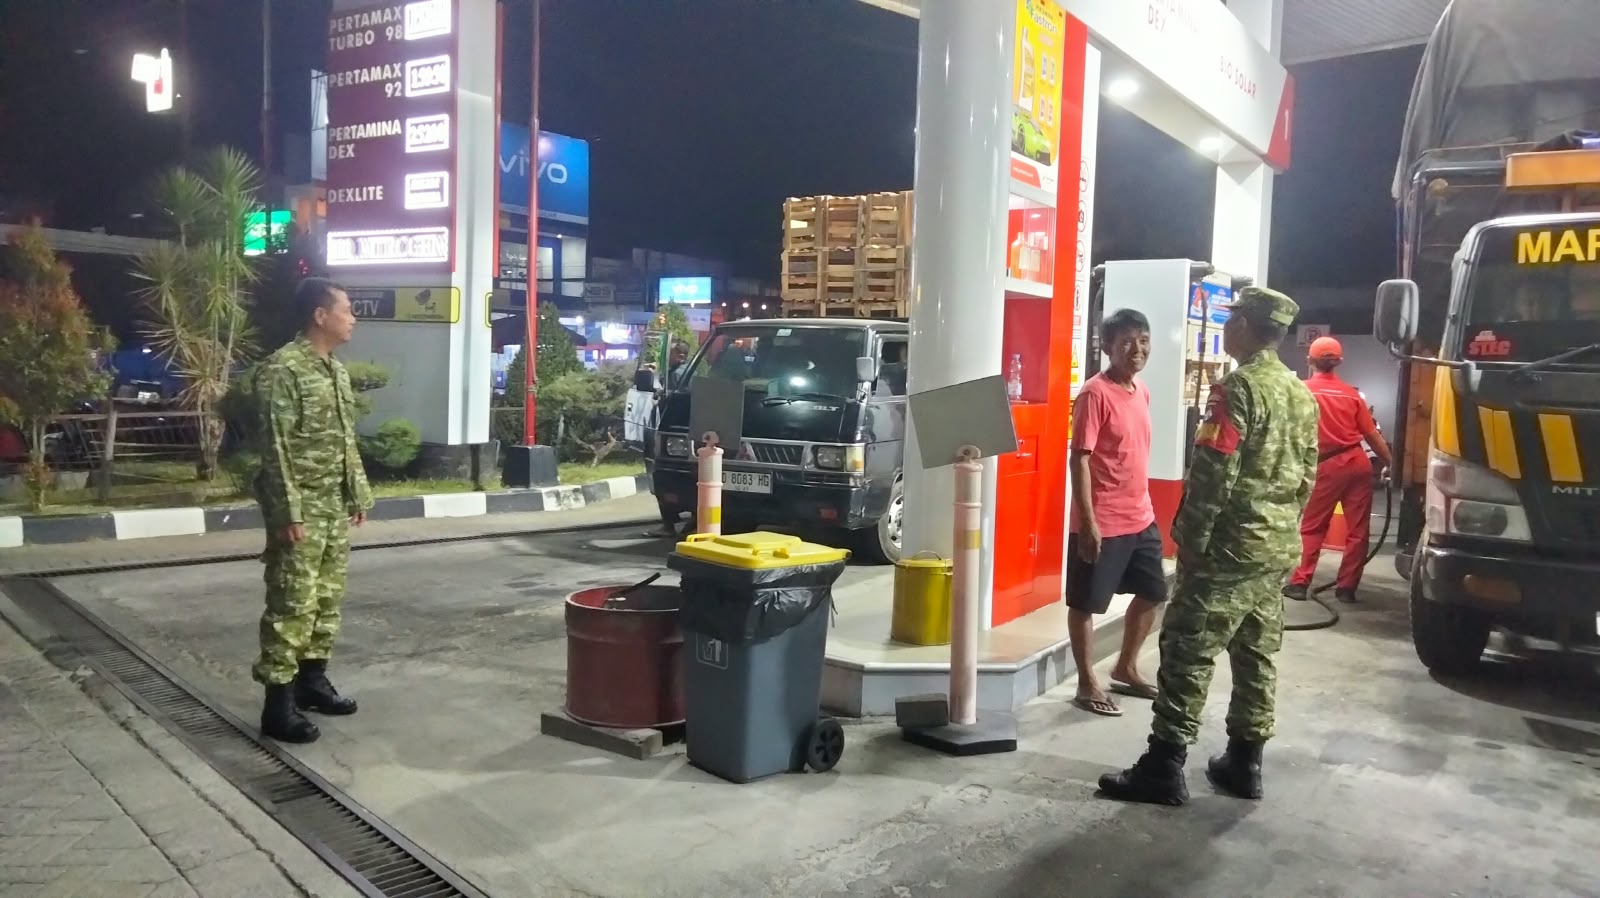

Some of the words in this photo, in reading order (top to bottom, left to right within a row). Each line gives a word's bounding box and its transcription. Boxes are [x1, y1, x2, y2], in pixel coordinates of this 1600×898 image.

[329, 6, 402, 34] PERTAMAX
[329, 31, 375, 51] TURBO
[385, 26, 403, 41] 98
[329, 63, 402, 88] PERTAMAX
[1235, 68, 1256, 99] SOLAR
[384, 82, 402, 98] 92
[329, 119, 402, 142] PERTAMINA
[329, 144, 355, 159] DEX
[328, 186, 383, 203] DEXLITE
[352, 300, 379, 316] CTV
[731, 473, 753, 486] 8083
